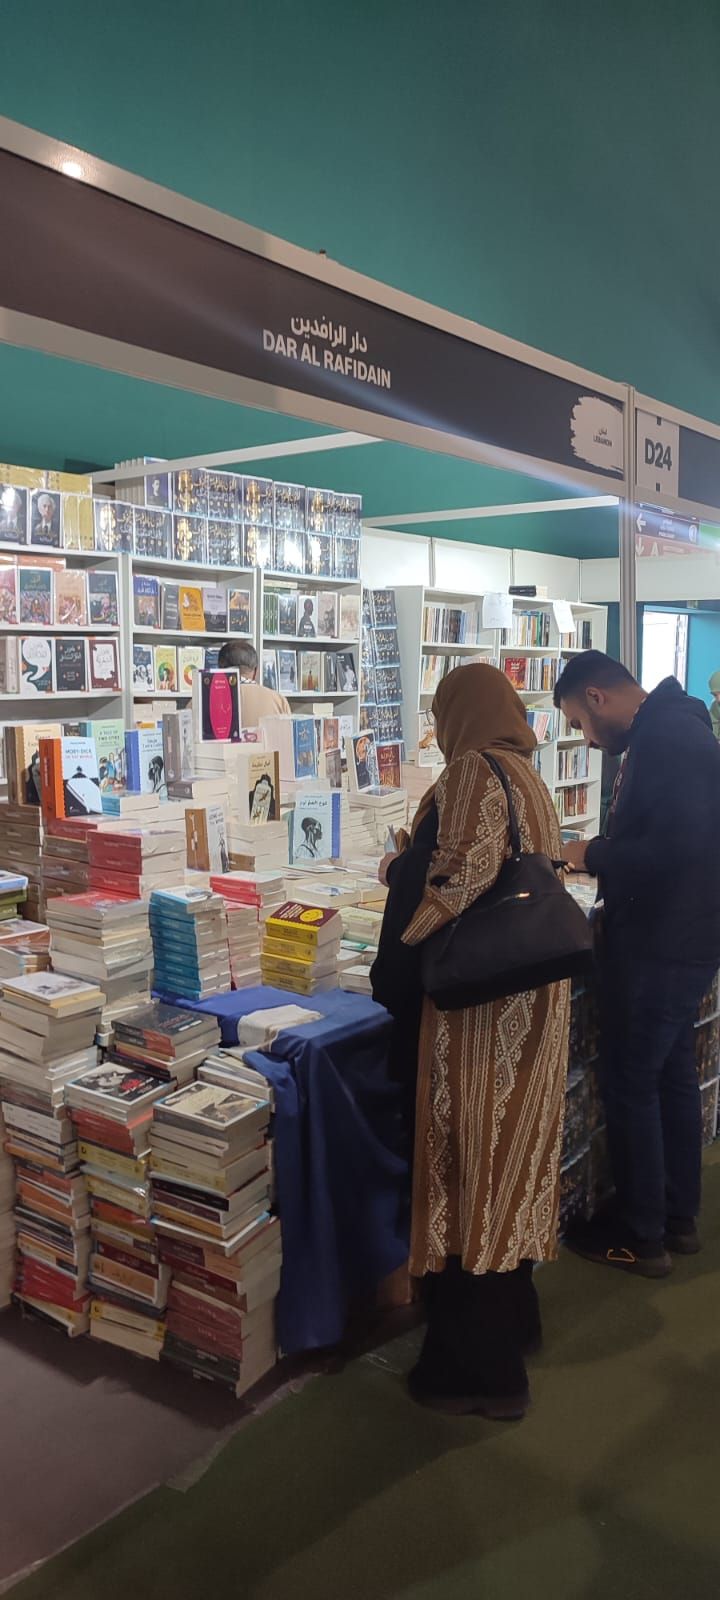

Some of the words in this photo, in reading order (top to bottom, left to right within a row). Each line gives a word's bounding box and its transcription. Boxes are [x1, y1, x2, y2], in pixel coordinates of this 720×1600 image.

[290, 316, 347, 348] الرافدين
[349, 331, 368, 353] دار
[263, 329, 298, 360] DAR
[300, 342, 321, 367] AL
[323, 350, 391, 389] RAFIDAIN
[593, 435, 613, 447] LEBANON
[644, 438, 673, 471] D24
